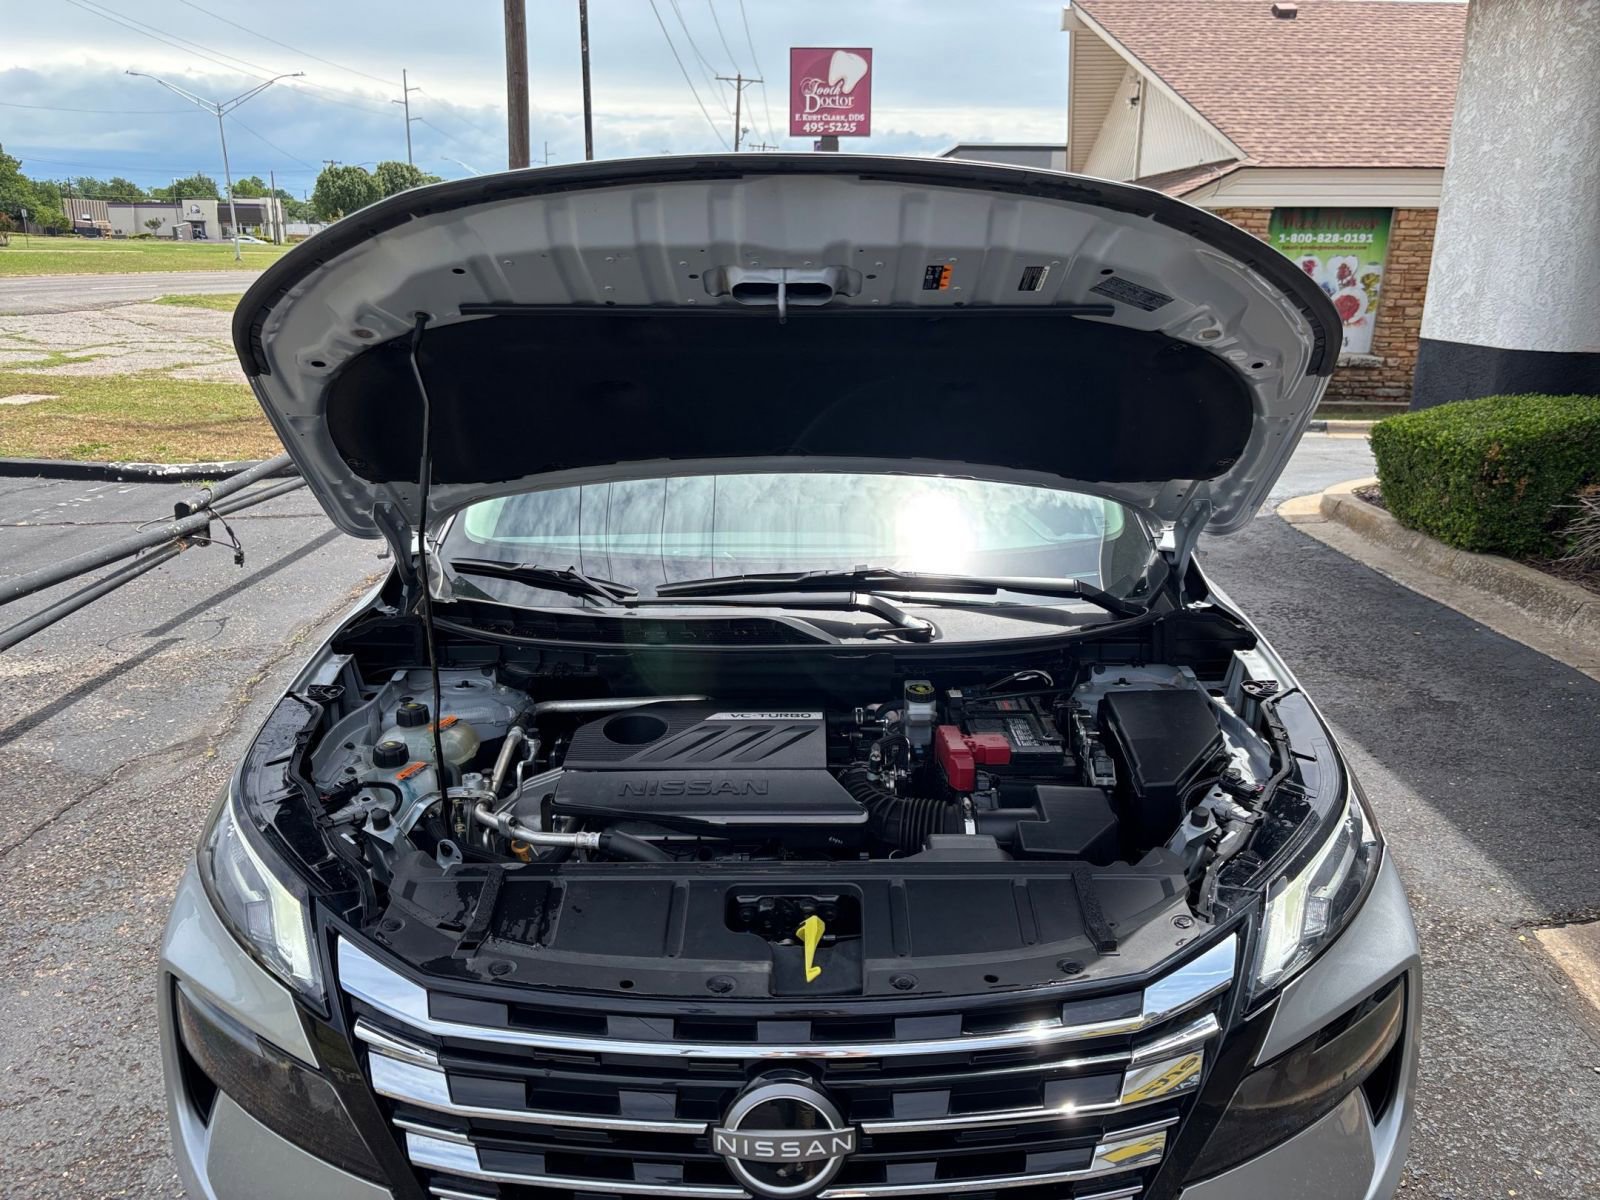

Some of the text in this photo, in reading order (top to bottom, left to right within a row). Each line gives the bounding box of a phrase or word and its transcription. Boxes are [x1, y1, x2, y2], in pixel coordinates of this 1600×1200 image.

[800, 77, 843, 95] Tooth
[803, 122, 857, 132] 495-5225
[1278, 233, 1374, 244] 1-800-828-0191
[618, 780, 769, 797] NISSAN
[717, 1134, 852, 1158] NISSAN
